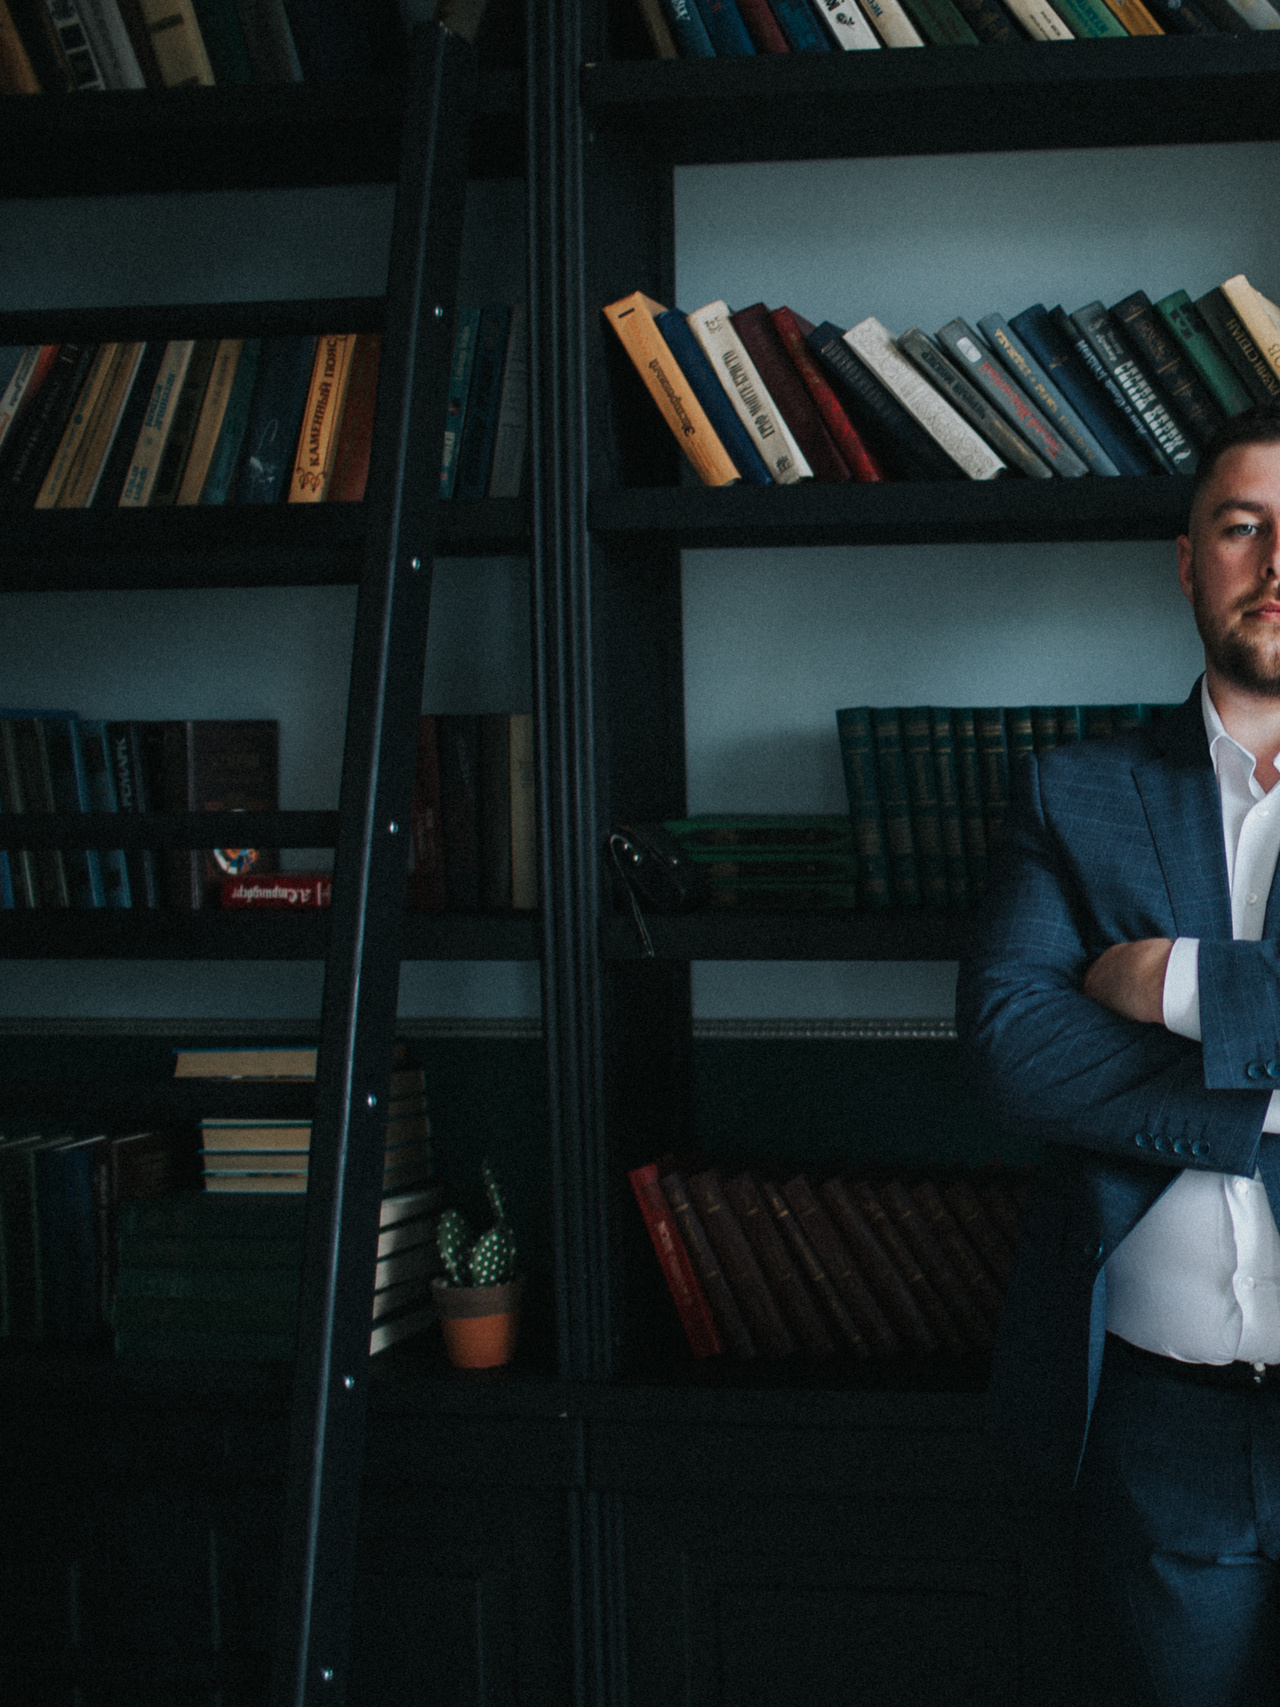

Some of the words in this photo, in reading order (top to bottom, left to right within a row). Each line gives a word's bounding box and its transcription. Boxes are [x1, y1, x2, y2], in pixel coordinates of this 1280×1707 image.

[1226, 316, 1259, 363] СТЕПАН
[308, 380, 332, 468] КАМЕННЫЙ
[321, 338, 339, 378] ПОЯС
[1111, 357, 1158, 412] СЕСТРА
[1142, 402, 1186, 455] КЕРРИ
